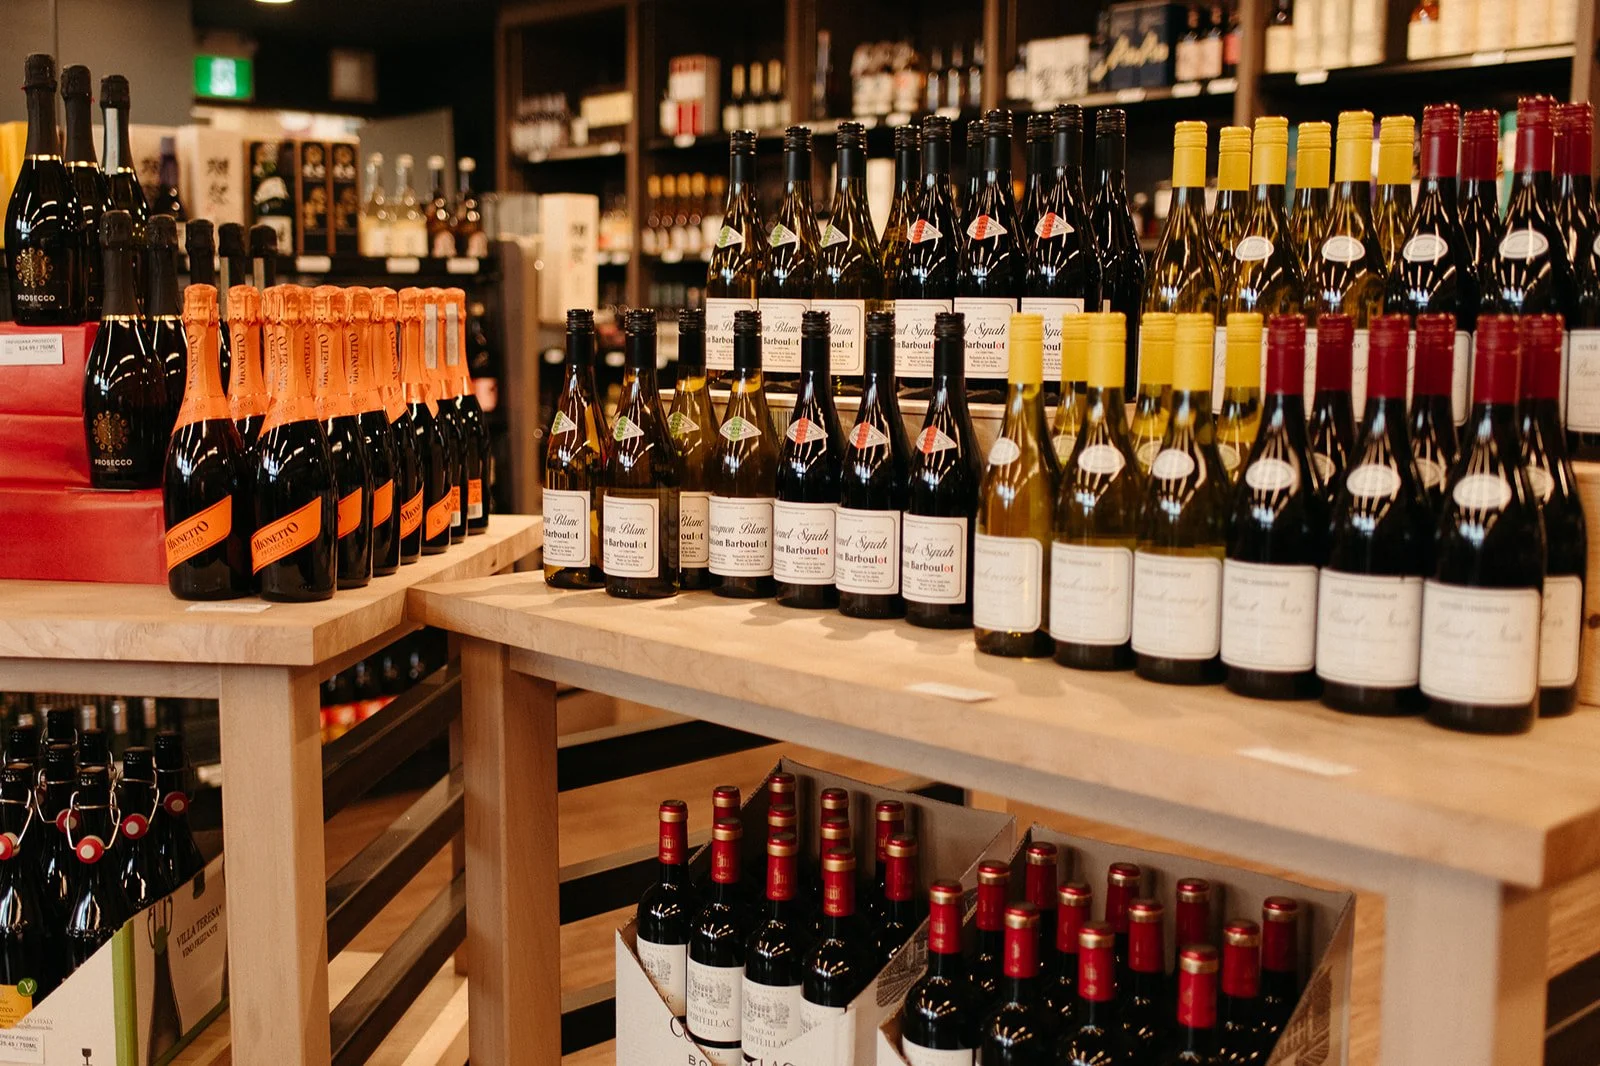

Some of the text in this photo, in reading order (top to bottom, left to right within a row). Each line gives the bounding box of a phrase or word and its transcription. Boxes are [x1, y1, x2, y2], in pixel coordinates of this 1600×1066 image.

[17, 294, 55, 302] PROSECCO
[831, 340, 854, 349] oulot
[94, 458, 133, 467] PROSECCO
[553, 513, 580, 527] Blanc
[618, 521, 648, 536] Blanc
[738, 521, 769, 535] Blanc
[166, 519, 210, 551] MIONETTO
[253, 520, 299, 551] MIONETTO
[681, 532, 704, 541] oulot
[725, 538, 768, 549] Barboulot
[785, 545, 829, 556] Barboulot
[844, 552, 887, 565] Barboulot
[910, 560, 954, 574] Barboulot
